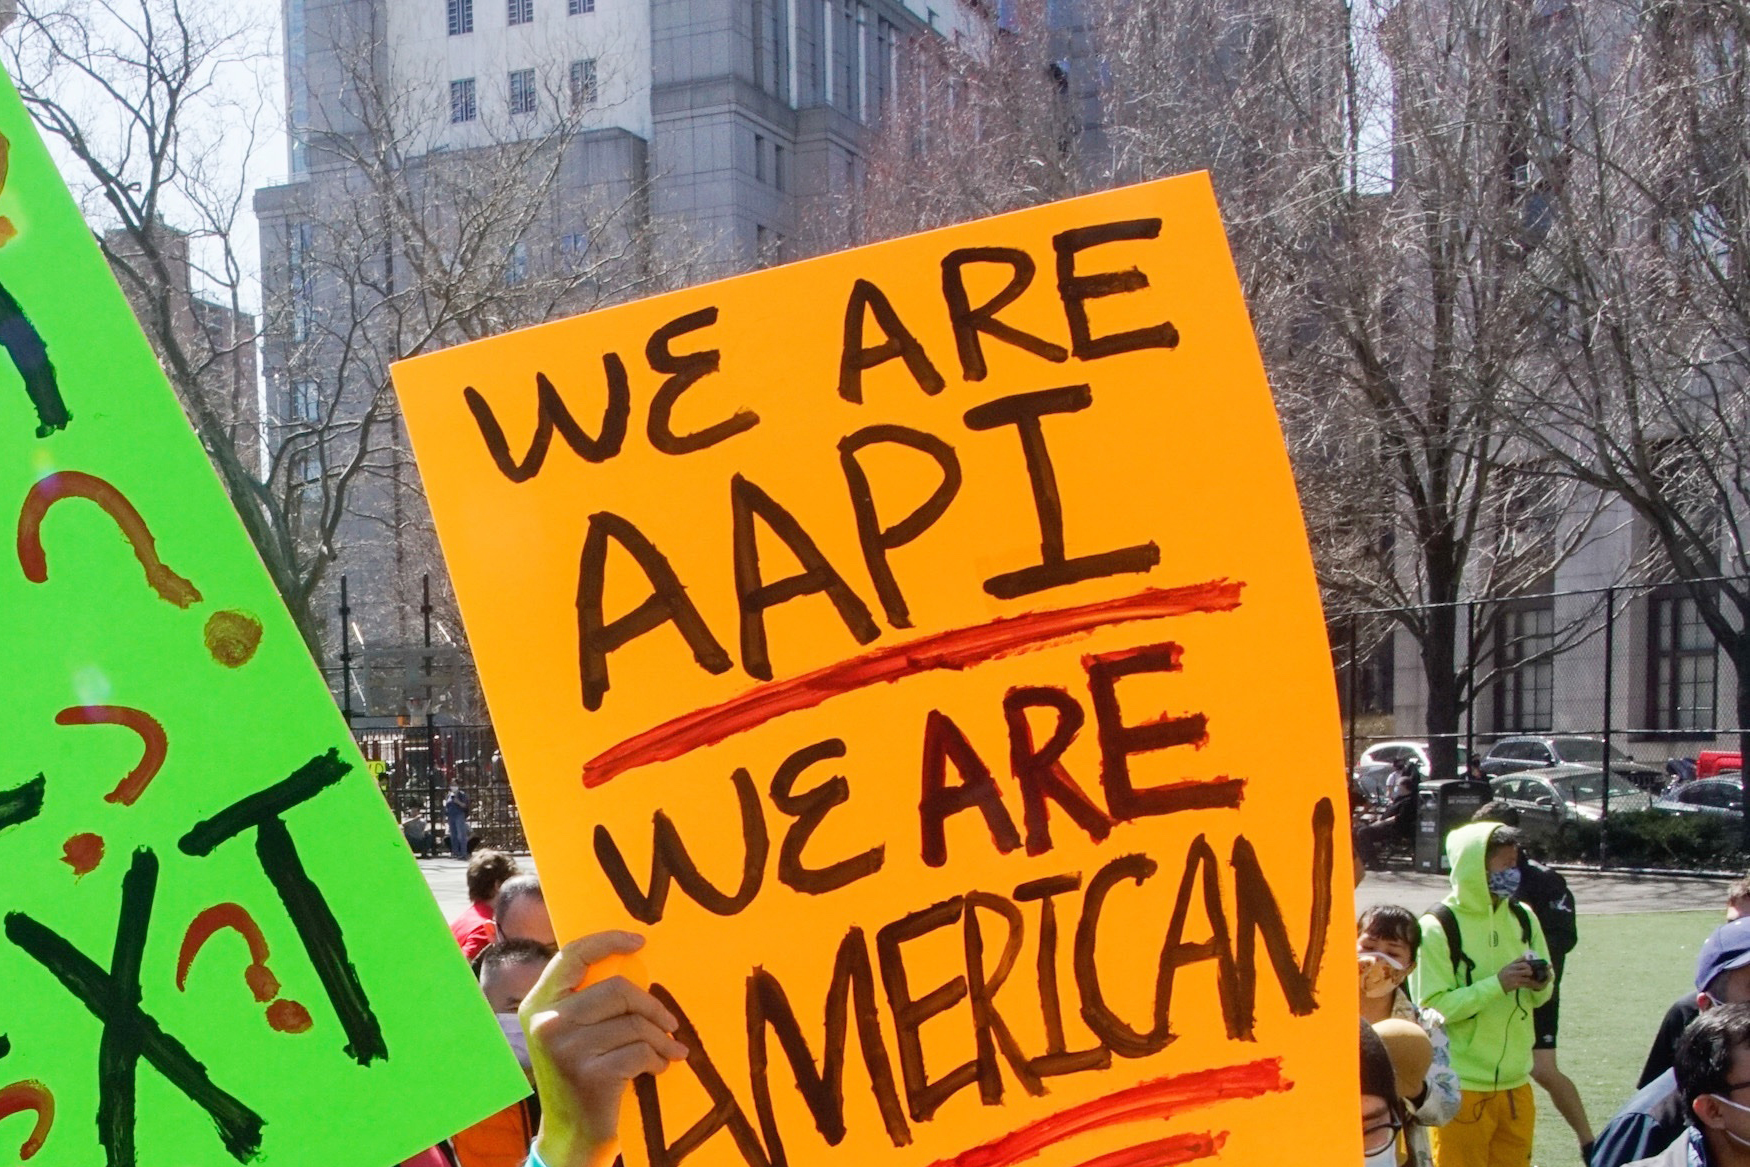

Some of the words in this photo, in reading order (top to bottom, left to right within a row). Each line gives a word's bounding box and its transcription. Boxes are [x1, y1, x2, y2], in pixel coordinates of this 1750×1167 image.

[463, 306, 759, 483] WE
[838, 217, 1180, 404] ARE
[576, 383, 1161, 712] AAPI
[594, 738, 885, 925] WE
[919, 640, 1246, 867] ARE
